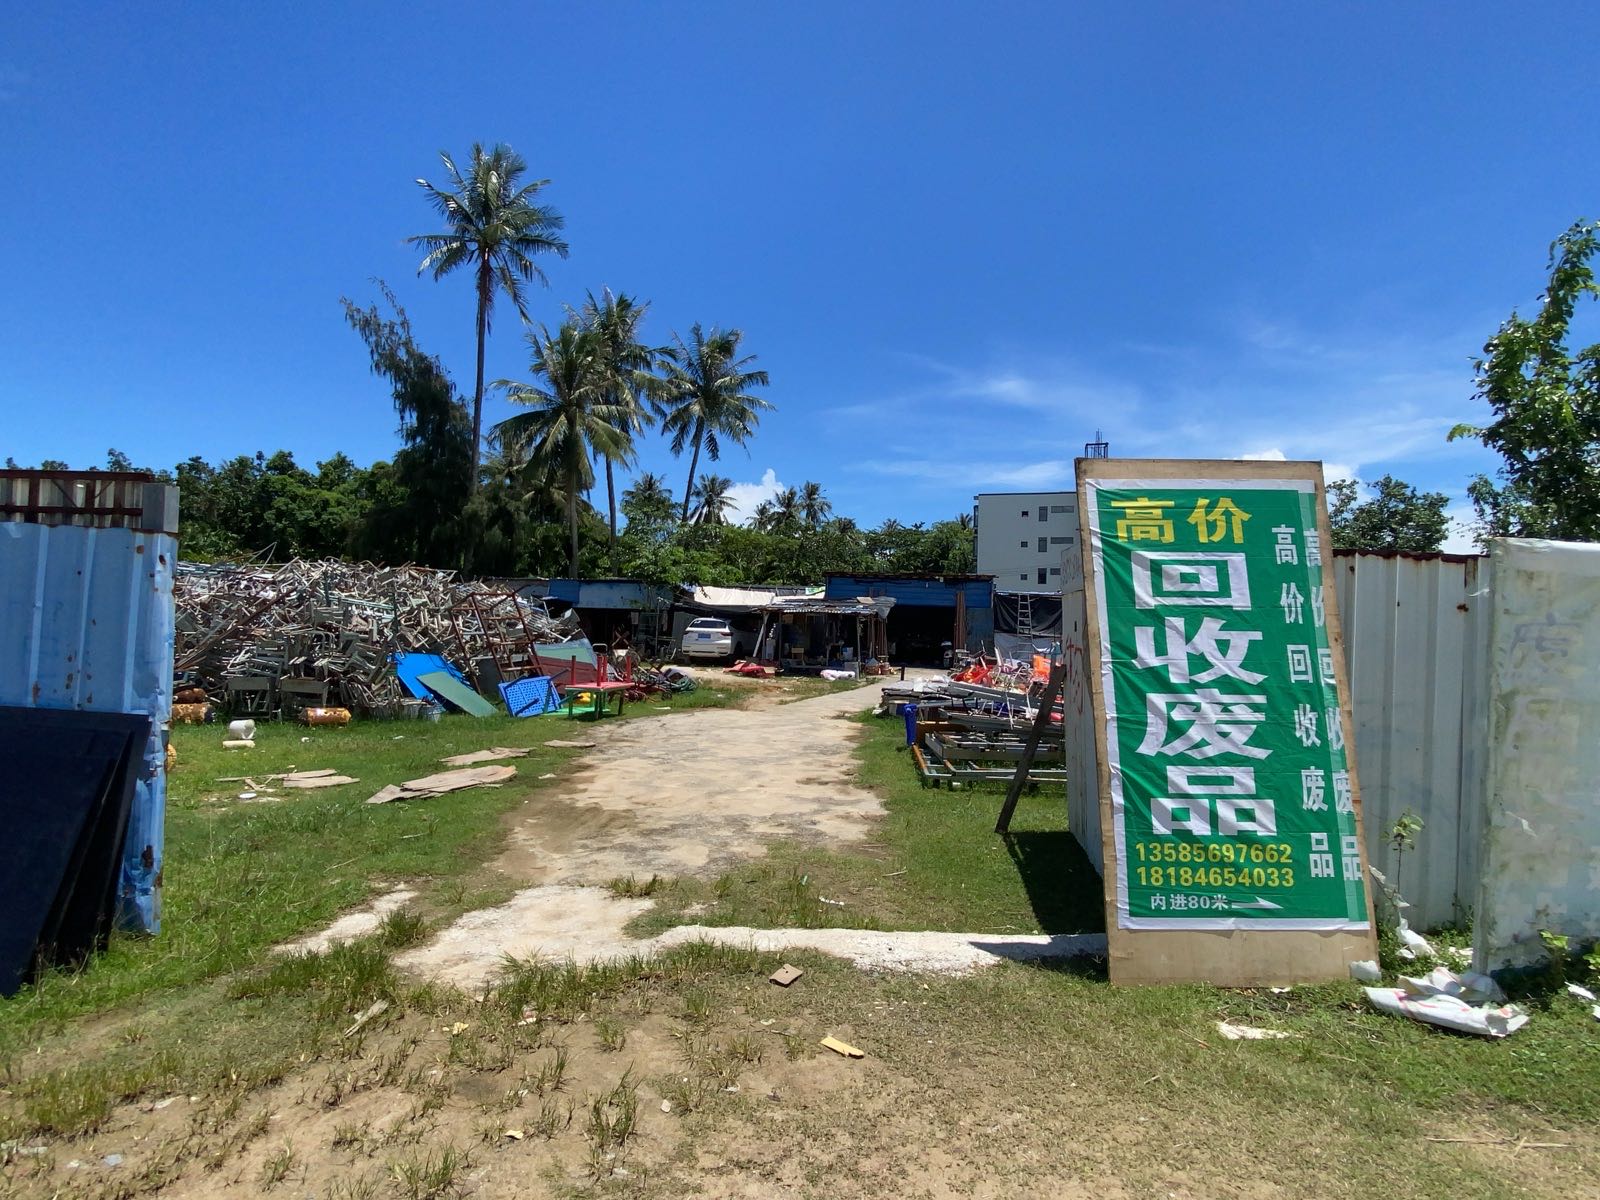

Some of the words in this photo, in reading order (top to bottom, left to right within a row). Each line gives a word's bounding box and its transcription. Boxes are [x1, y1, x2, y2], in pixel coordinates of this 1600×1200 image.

[1110, 497, 1252, 544] 高价
[1130, 551, 1278, 836] 回收废品
[1271, 524, 1335, 878] 高价回收废品
[1135, 842, 1293, 864] 13585697662
[1136, 866, 1295, 887] 18184654033
[1150, 893, 1229, 911] 内进80米
